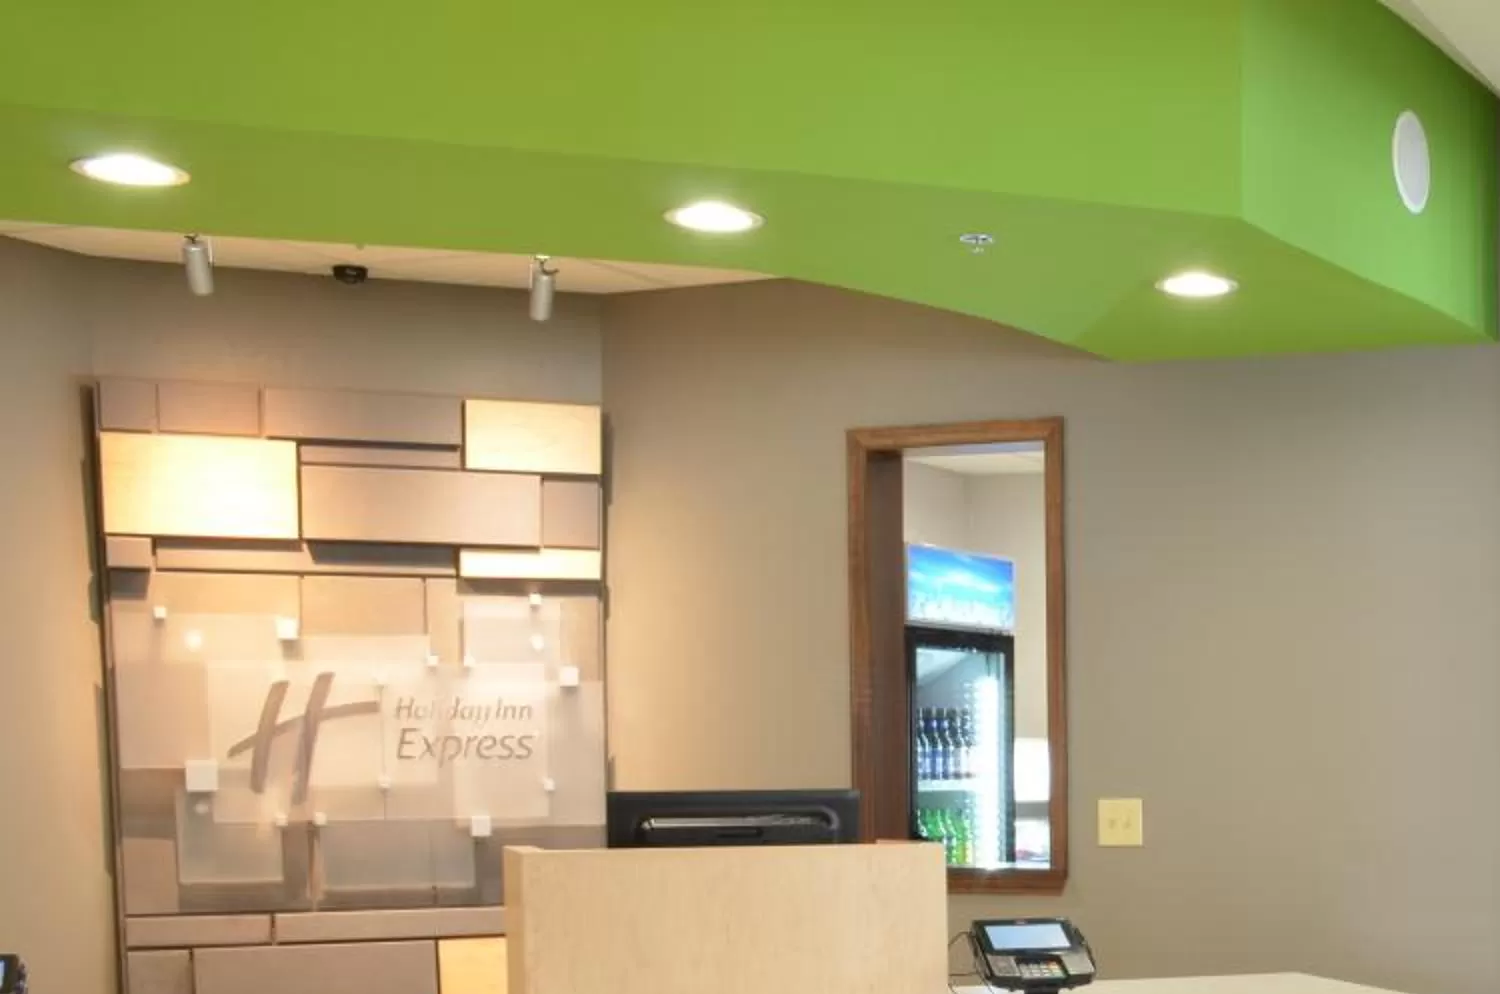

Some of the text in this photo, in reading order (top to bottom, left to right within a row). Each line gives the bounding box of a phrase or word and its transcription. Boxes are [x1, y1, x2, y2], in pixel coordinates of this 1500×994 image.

[394, 697, 533, 727] Holday Inn
[396, 727, 536, 768] Express
